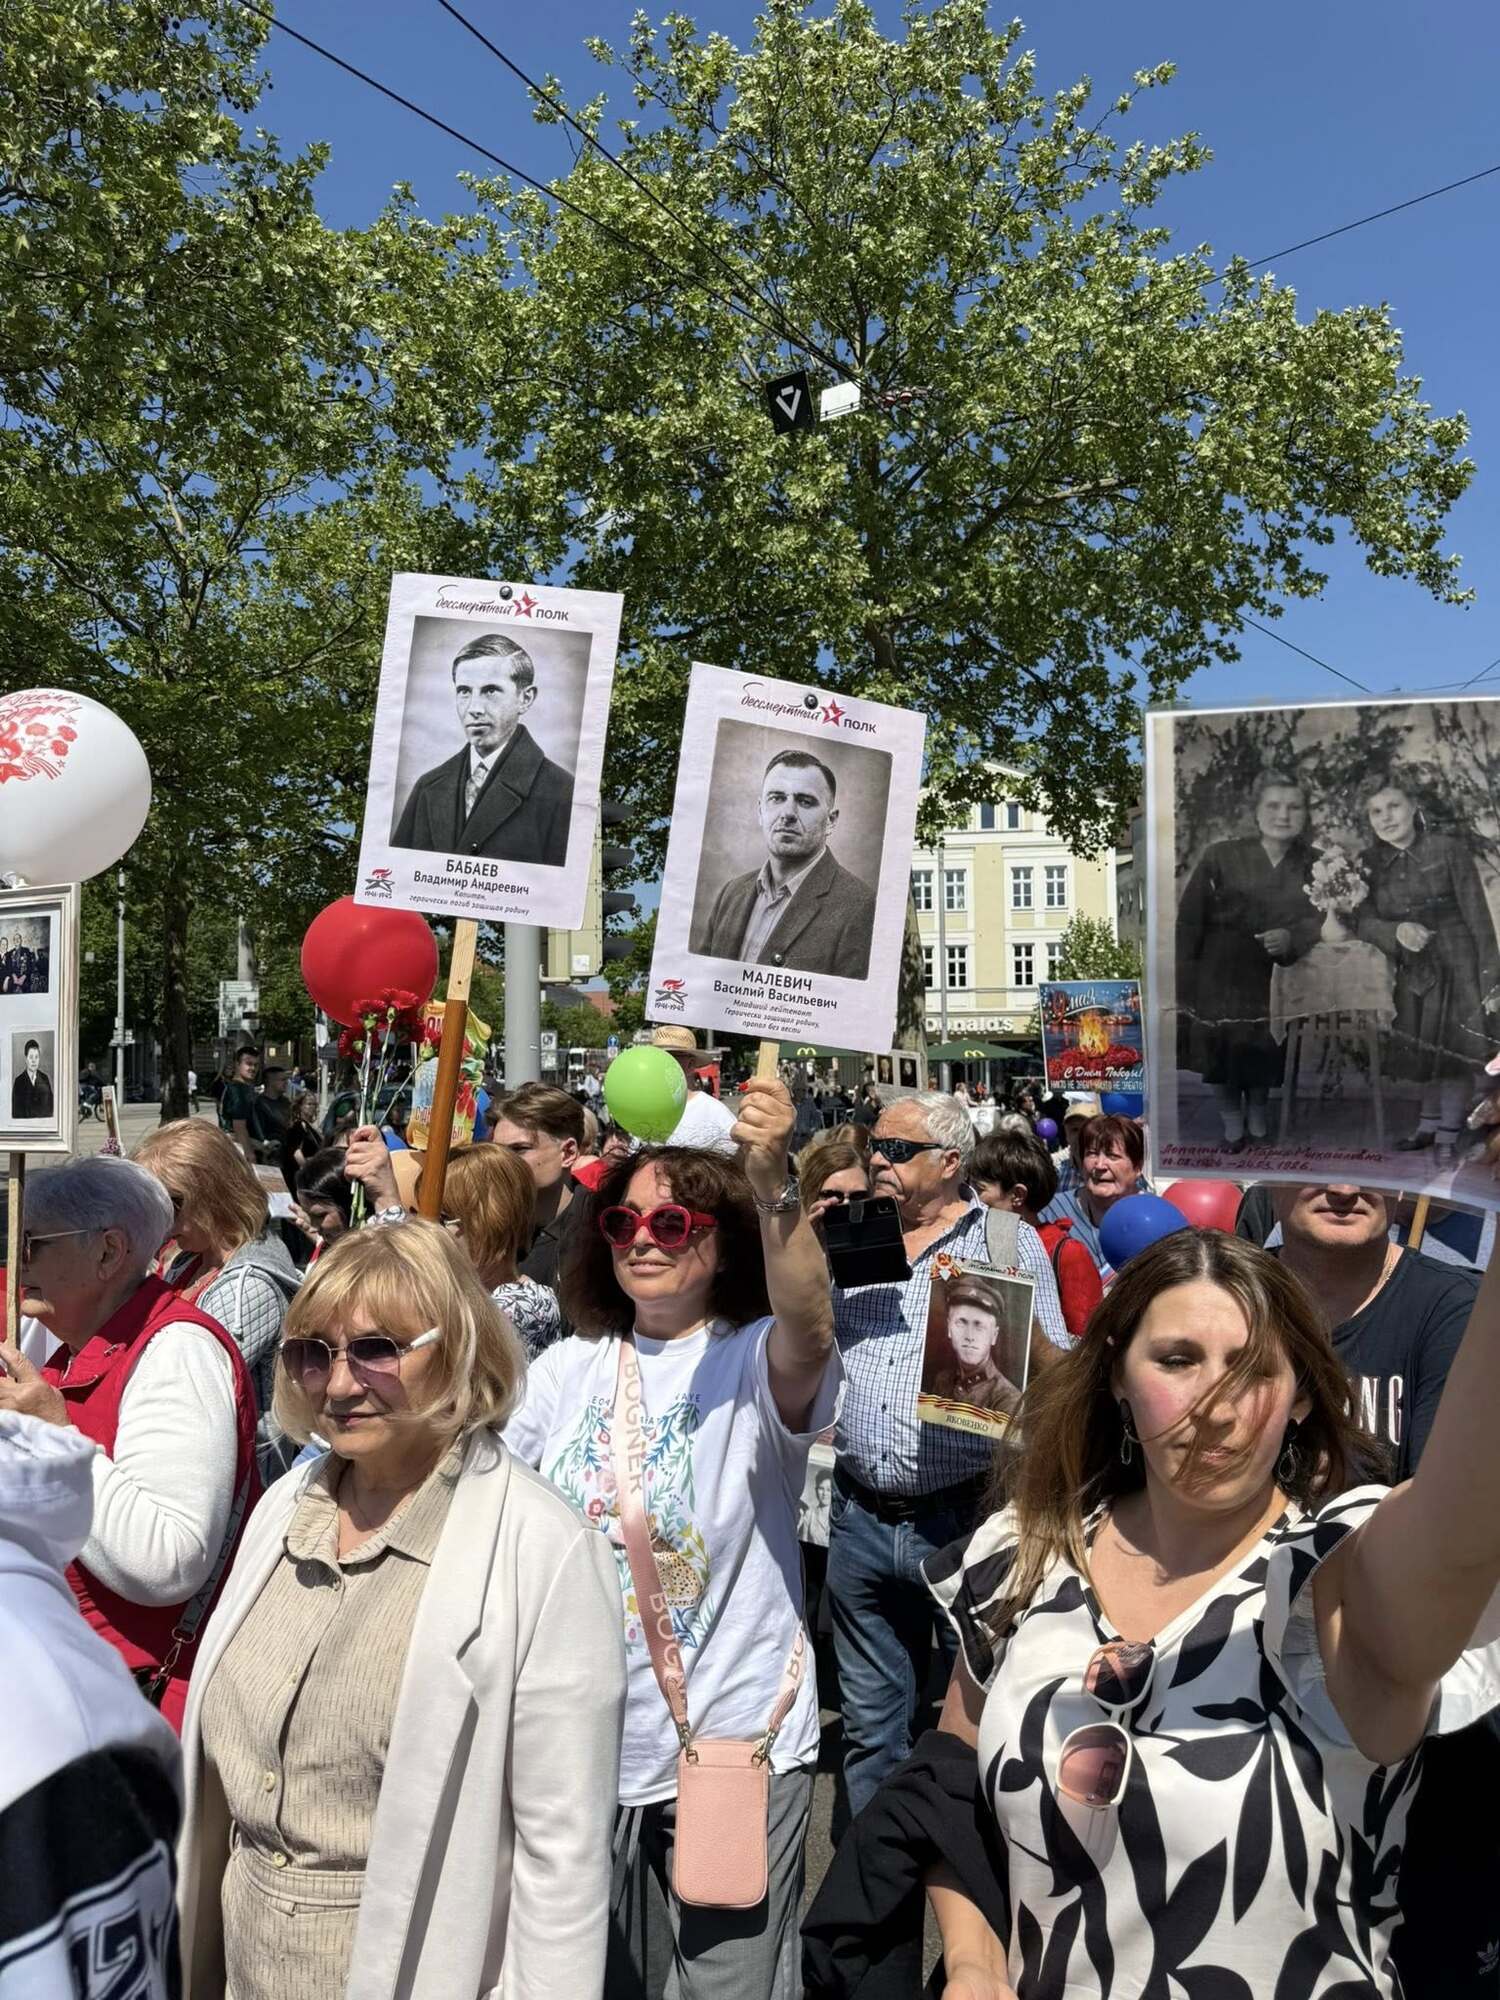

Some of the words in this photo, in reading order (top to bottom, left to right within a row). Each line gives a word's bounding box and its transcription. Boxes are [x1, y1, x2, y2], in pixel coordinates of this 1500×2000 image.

[445, 859, 499, 877] БАБАЕВ
[413, 870, 469, 889] Владимир
[471, 879, 530, 895] Андреевич
[742, 969, 812, 991] МАЛЕВИЧ
[714, 980, 764, 998] Василий
[768, 988, 838, 1010] Васильевич
[624, 1361, 643, 1495] BOGNER
